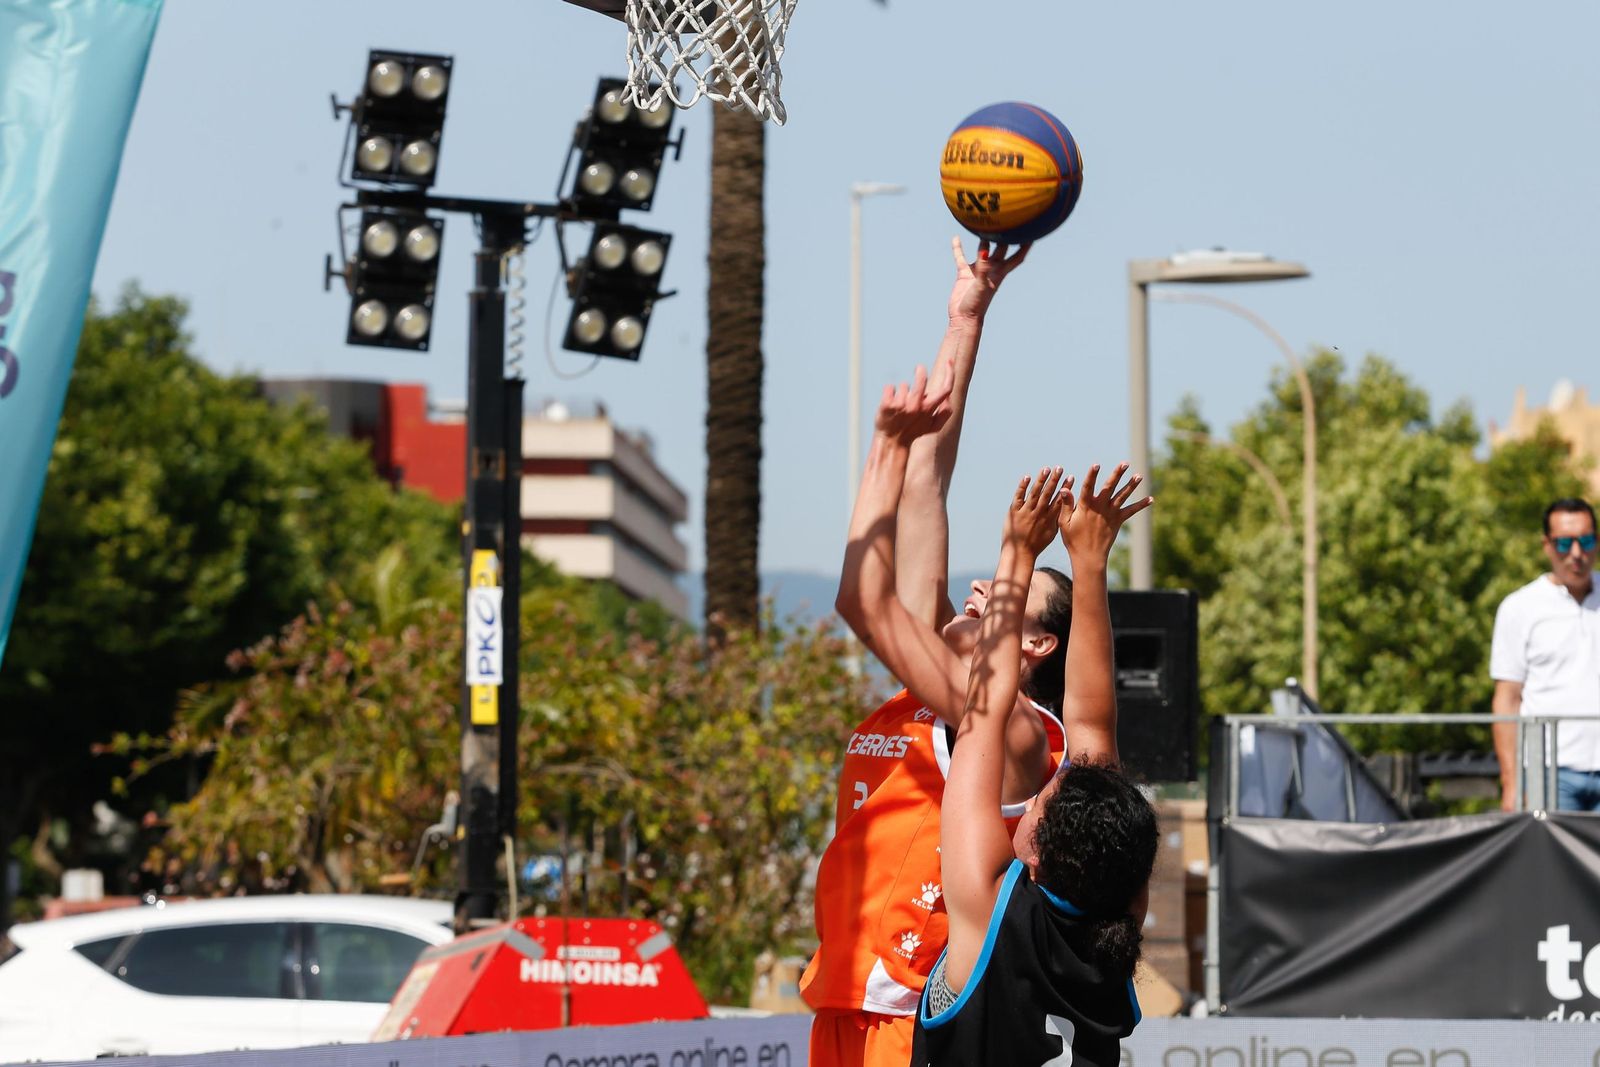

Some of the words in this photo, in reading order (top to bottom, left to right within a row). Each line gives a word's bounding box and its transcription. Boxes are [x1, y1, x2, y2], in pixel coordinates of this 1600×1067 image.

[944, 139, 1024, 170] Wilson
[911, 897, 935, 911] KELM
[893, 946, 918, 959] KELM
[520, 957, 659, 987] HIMOINSA
[670, 1036, 749, 1067] online
[758, 1042, 791, 1067] en
[1162, 1035, 1357, 1067] online
[1386, 1046, 1471, 1067] en
